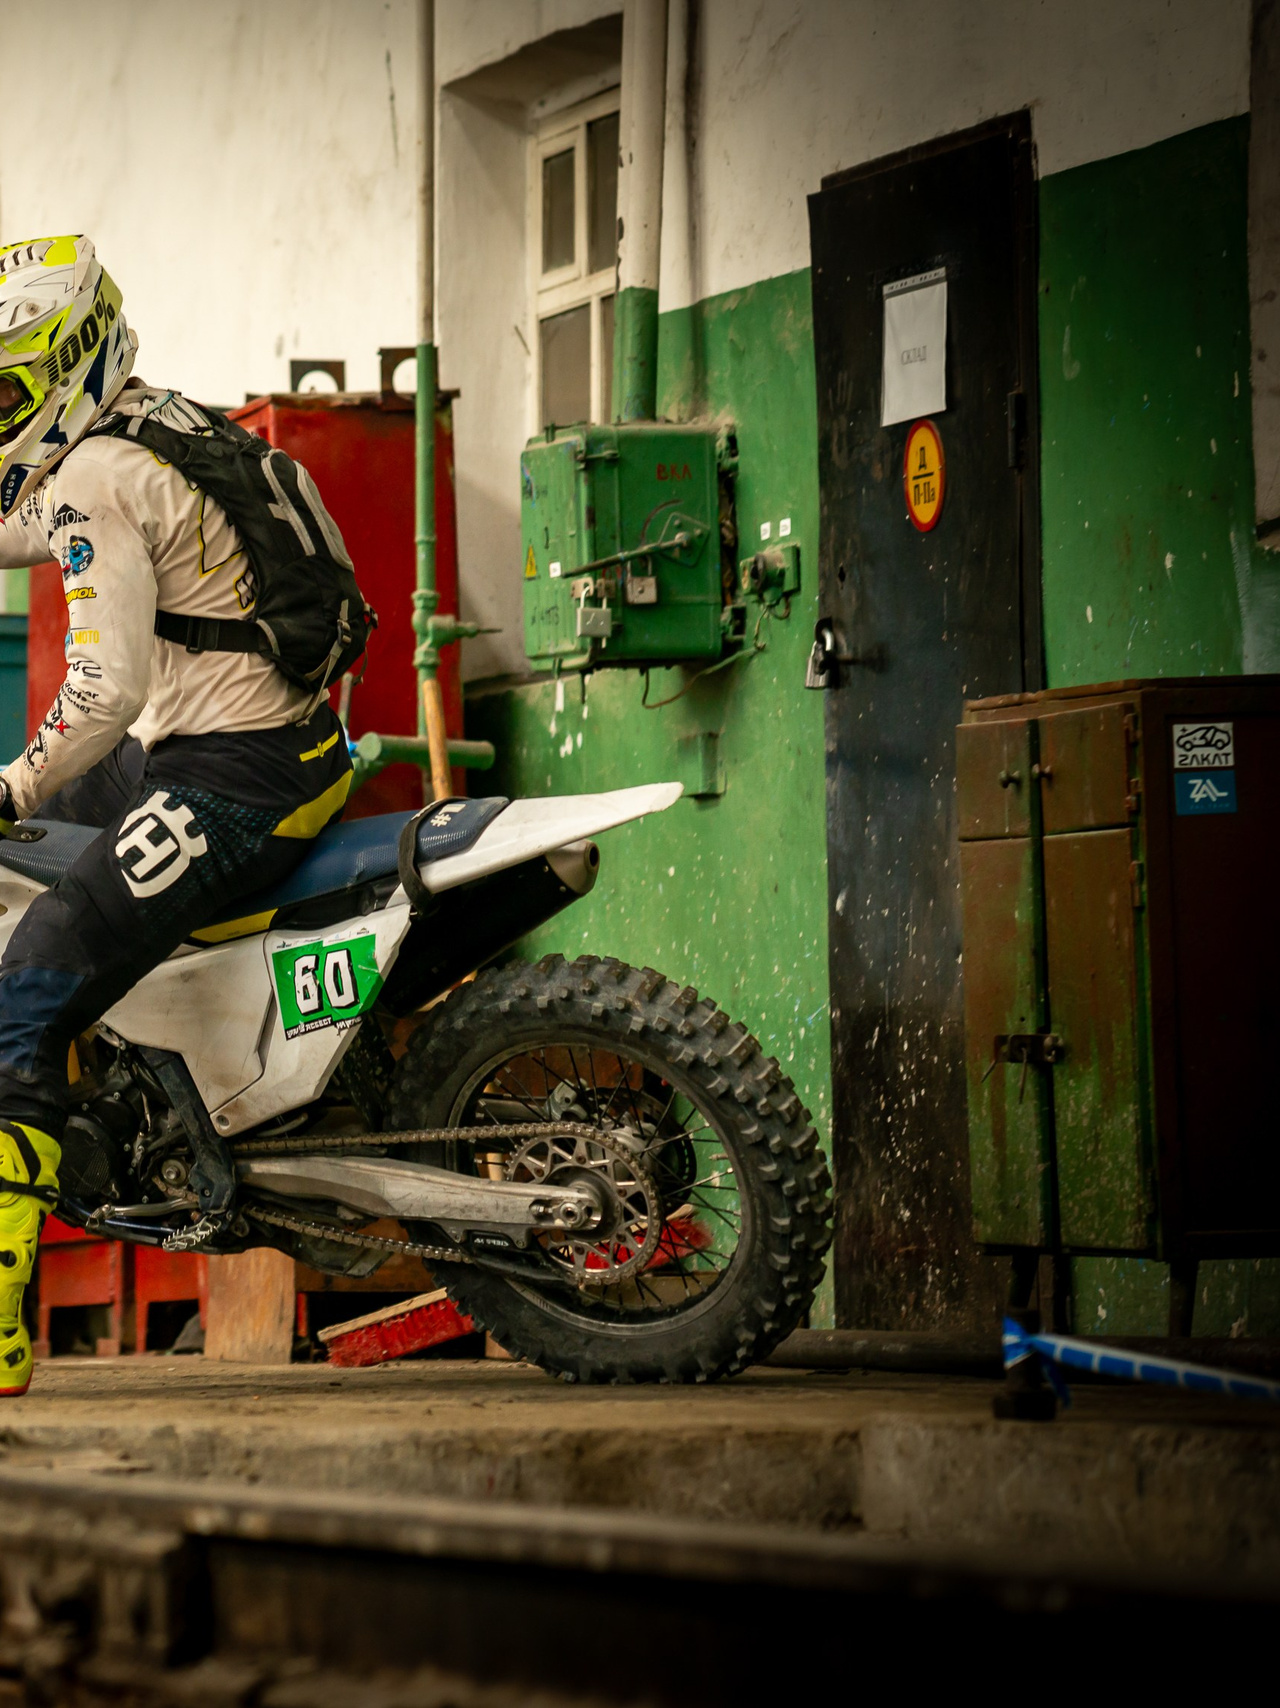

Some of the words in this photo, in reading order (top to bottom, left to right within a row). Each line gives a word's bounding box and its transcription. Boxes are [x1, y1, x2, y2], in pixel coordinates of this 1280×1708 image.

[41, 291, 115, 387] 100%
[655, 462, 692, 481] ВКЛ
[74, 630, 100, 645] MOTO
[294, 949, 359, 1015] 60
